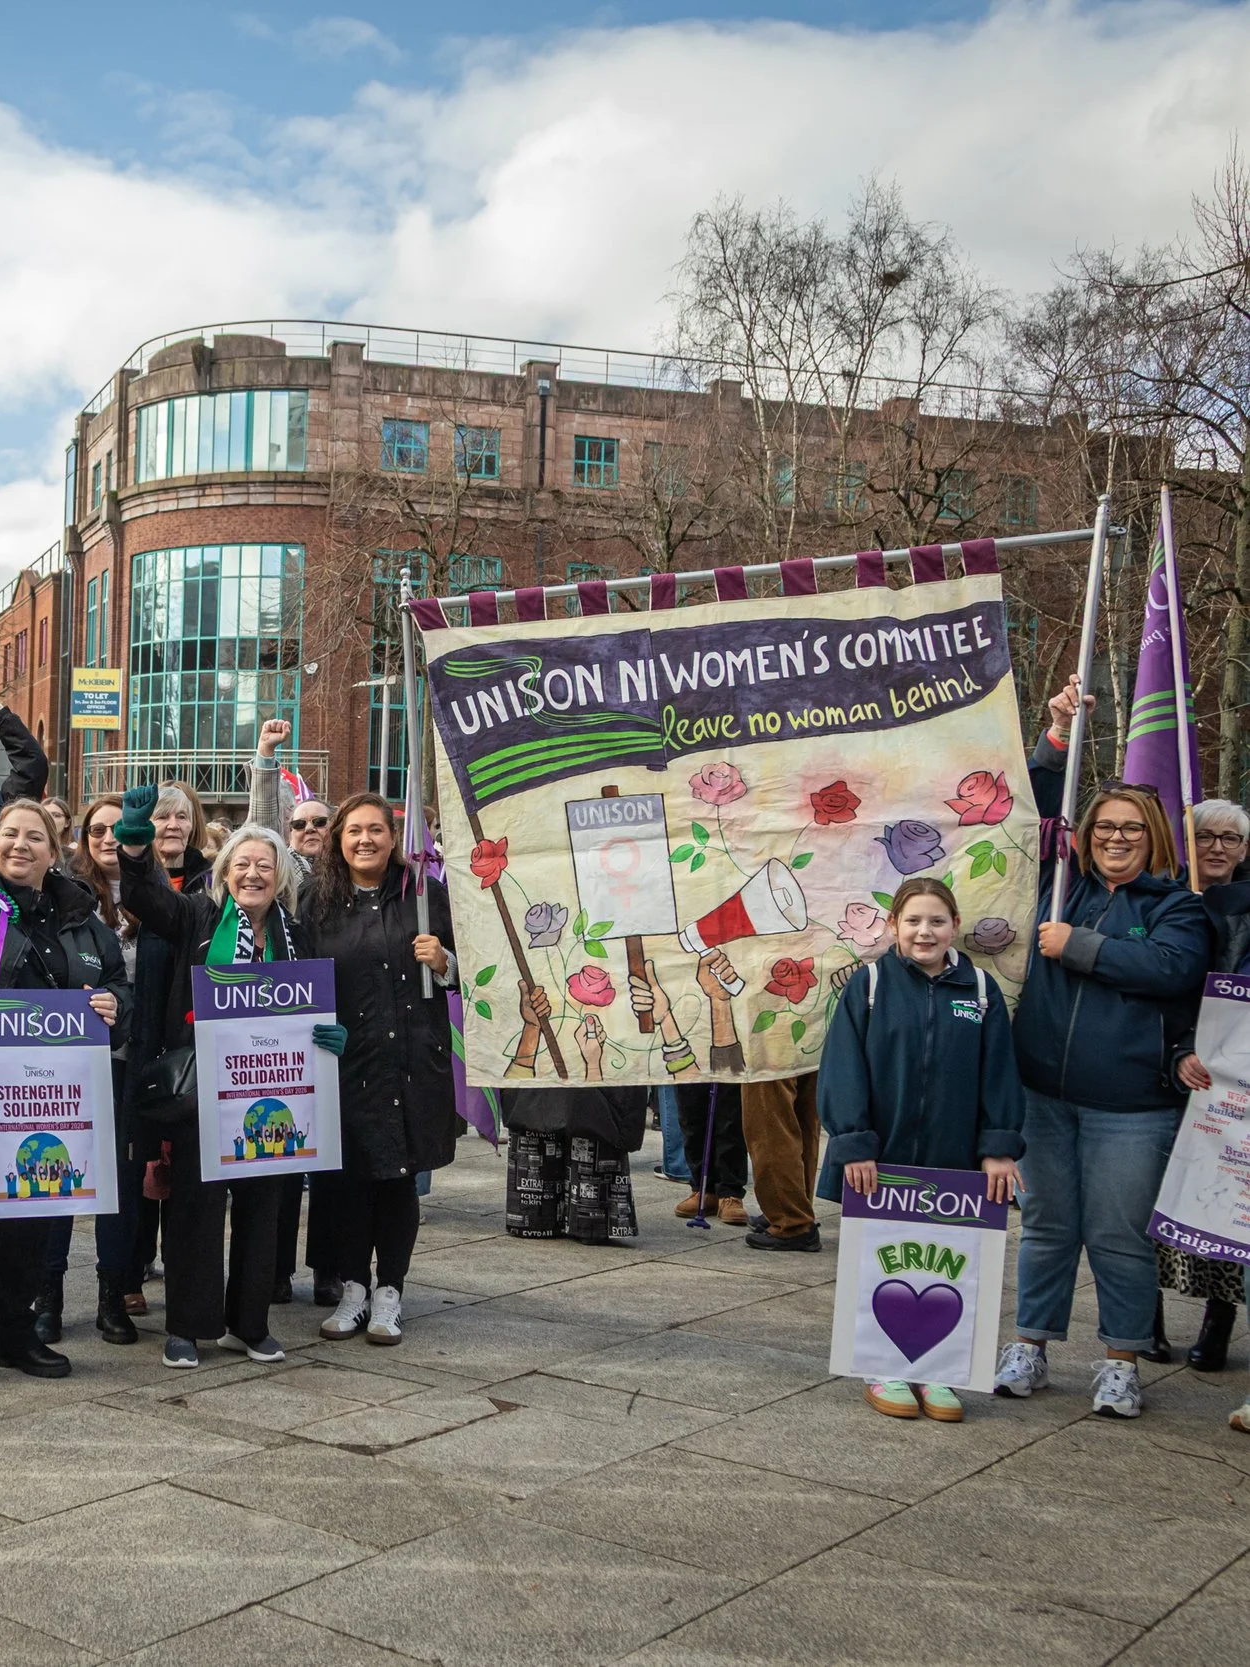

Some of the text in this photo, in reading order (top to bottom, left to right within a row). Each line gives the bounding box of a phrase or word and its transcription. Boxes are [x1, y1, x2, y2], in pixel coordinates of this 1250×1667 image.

[451, 615, 992, 735] UNISON NI WOMEN'S COMMITEE
[662, 664, 982, 751] leave no woman behind
[575, 800, 653, 827] UNISON
[214, 982, 313, 1010] UNISON
[252, 1038, 279, 1047] UNISON
[225, 1051, 305, 1070] STRENGTH IN
[25, 1069, 55, 1078] UNISON
[231, 1067, 304, 1086] SOLIDARITY
[68, 1084, 81, 1099] IN
[226, 1091, 261, 1099] INTERNATIONAL
[3, 1101, 80, 1118] SOLIDARITY
[1207, 1103, 1245, 1121] Builder
[1193, 1120, 1223, 1136] inspire
[866, 1187, 983, 1218] UNISON
[877, 1241, 967, 1281] ERIN
